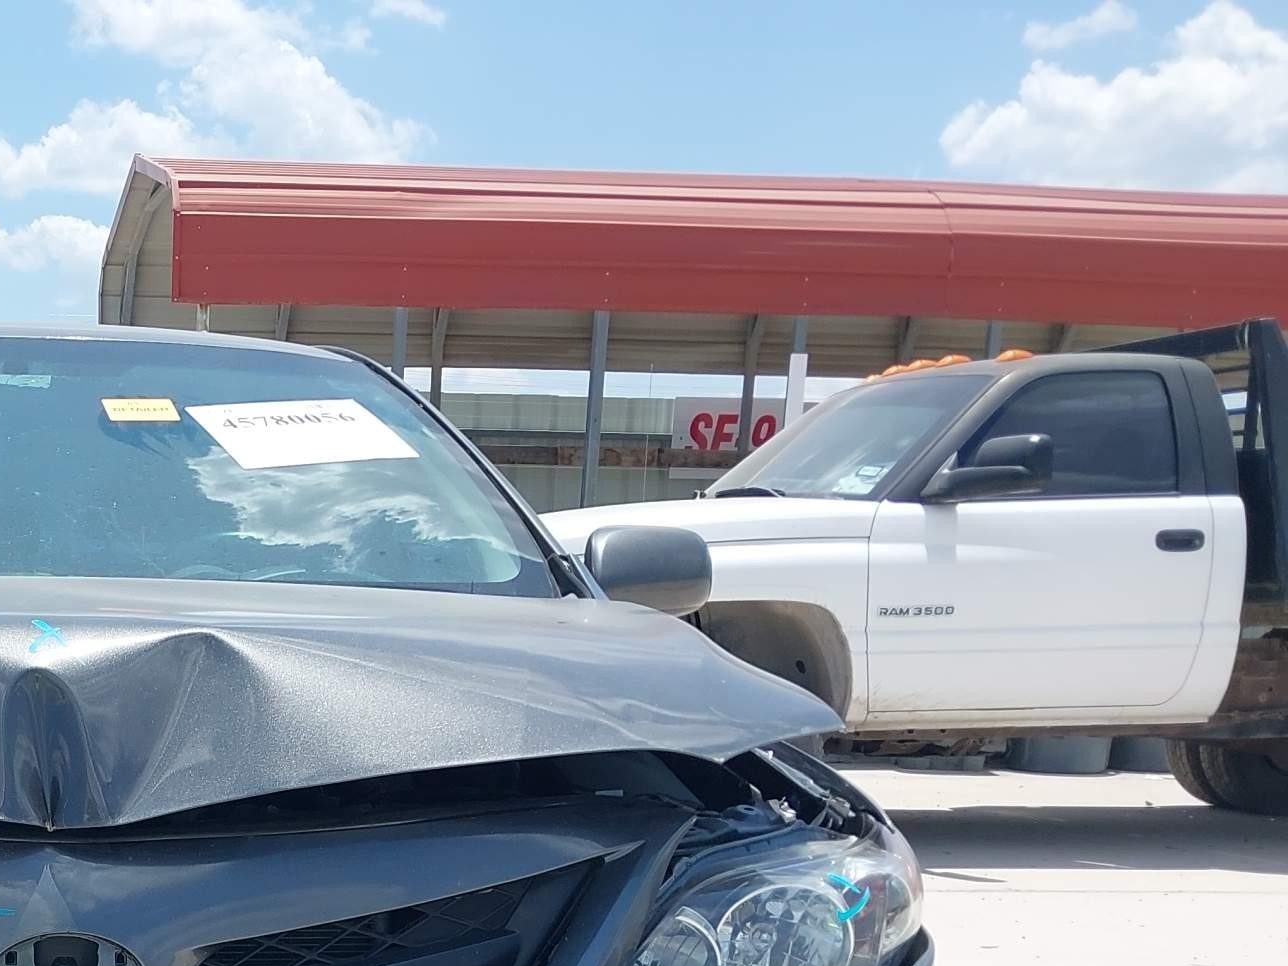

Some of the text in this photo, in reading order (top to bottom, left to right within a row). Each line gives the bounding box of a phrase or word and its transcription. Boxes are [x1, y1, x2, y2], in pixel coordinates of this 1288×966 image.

[222, 411, 357, 431] 45780056
[879, 605, 956, 617] RAM 3500
